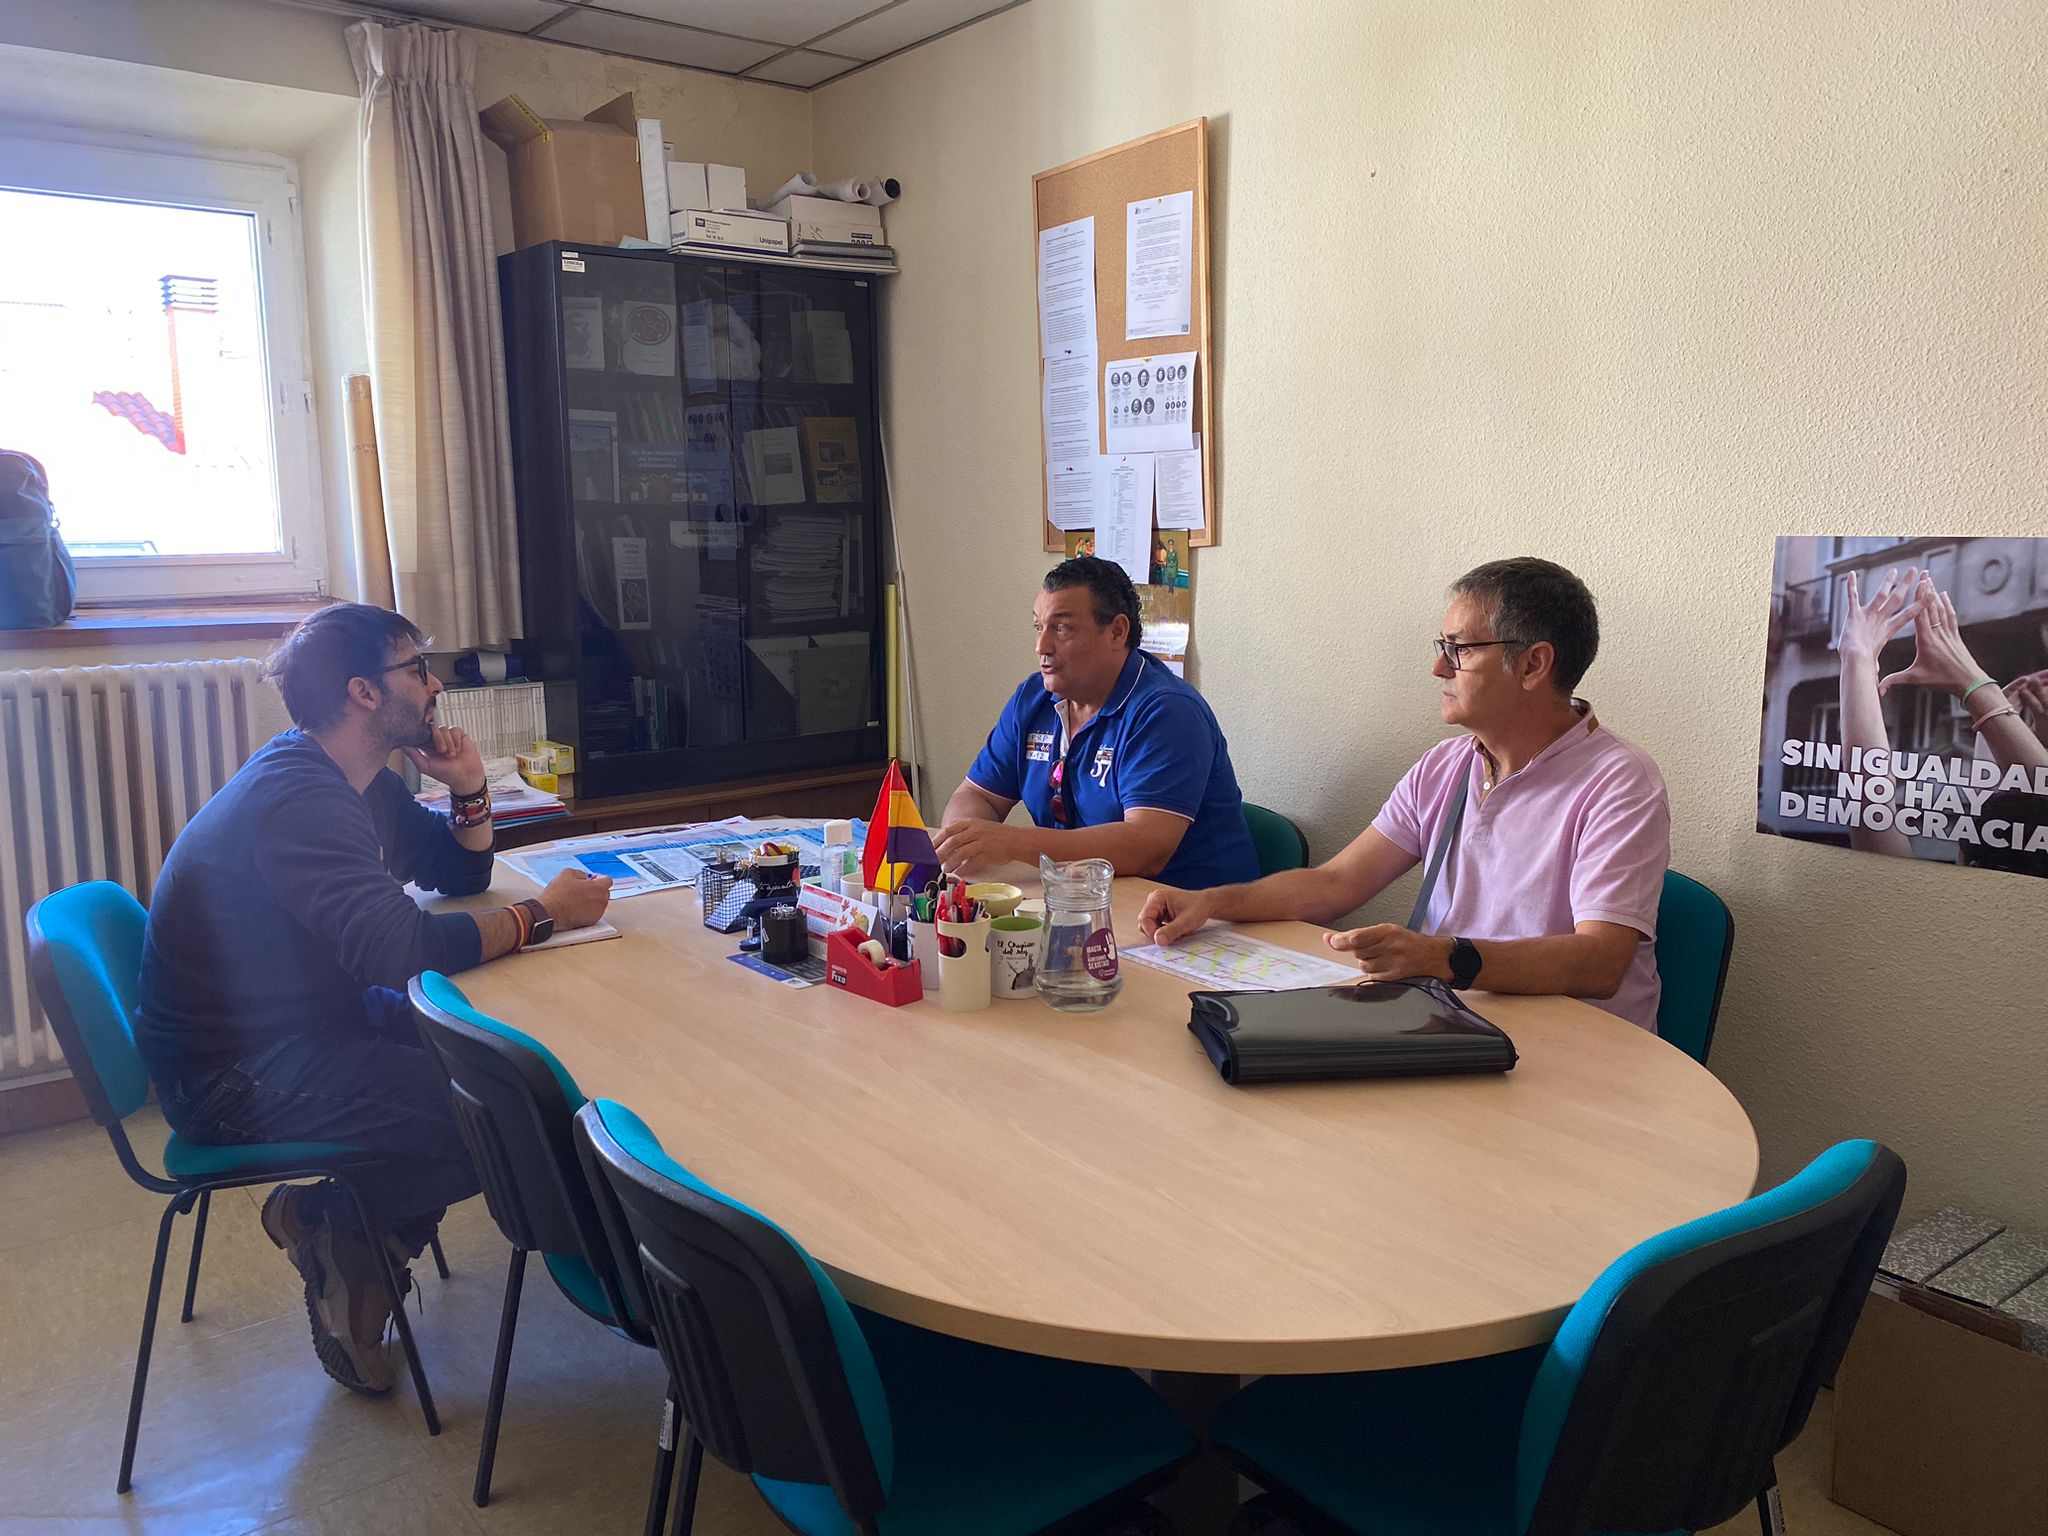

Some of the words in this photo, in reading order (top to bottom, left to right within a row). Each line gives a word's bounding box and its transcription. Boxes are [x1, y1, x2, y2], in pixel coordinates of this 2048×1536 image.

[760, 236, 784, 246] Unipapel
[1780, 738, 1842, 771] SIN
[1837, 772, 1895, 804] NO
[1904, 780, 1995, 817] HAY
[1779, 791, 2048, 853] DEMOCRACIA
